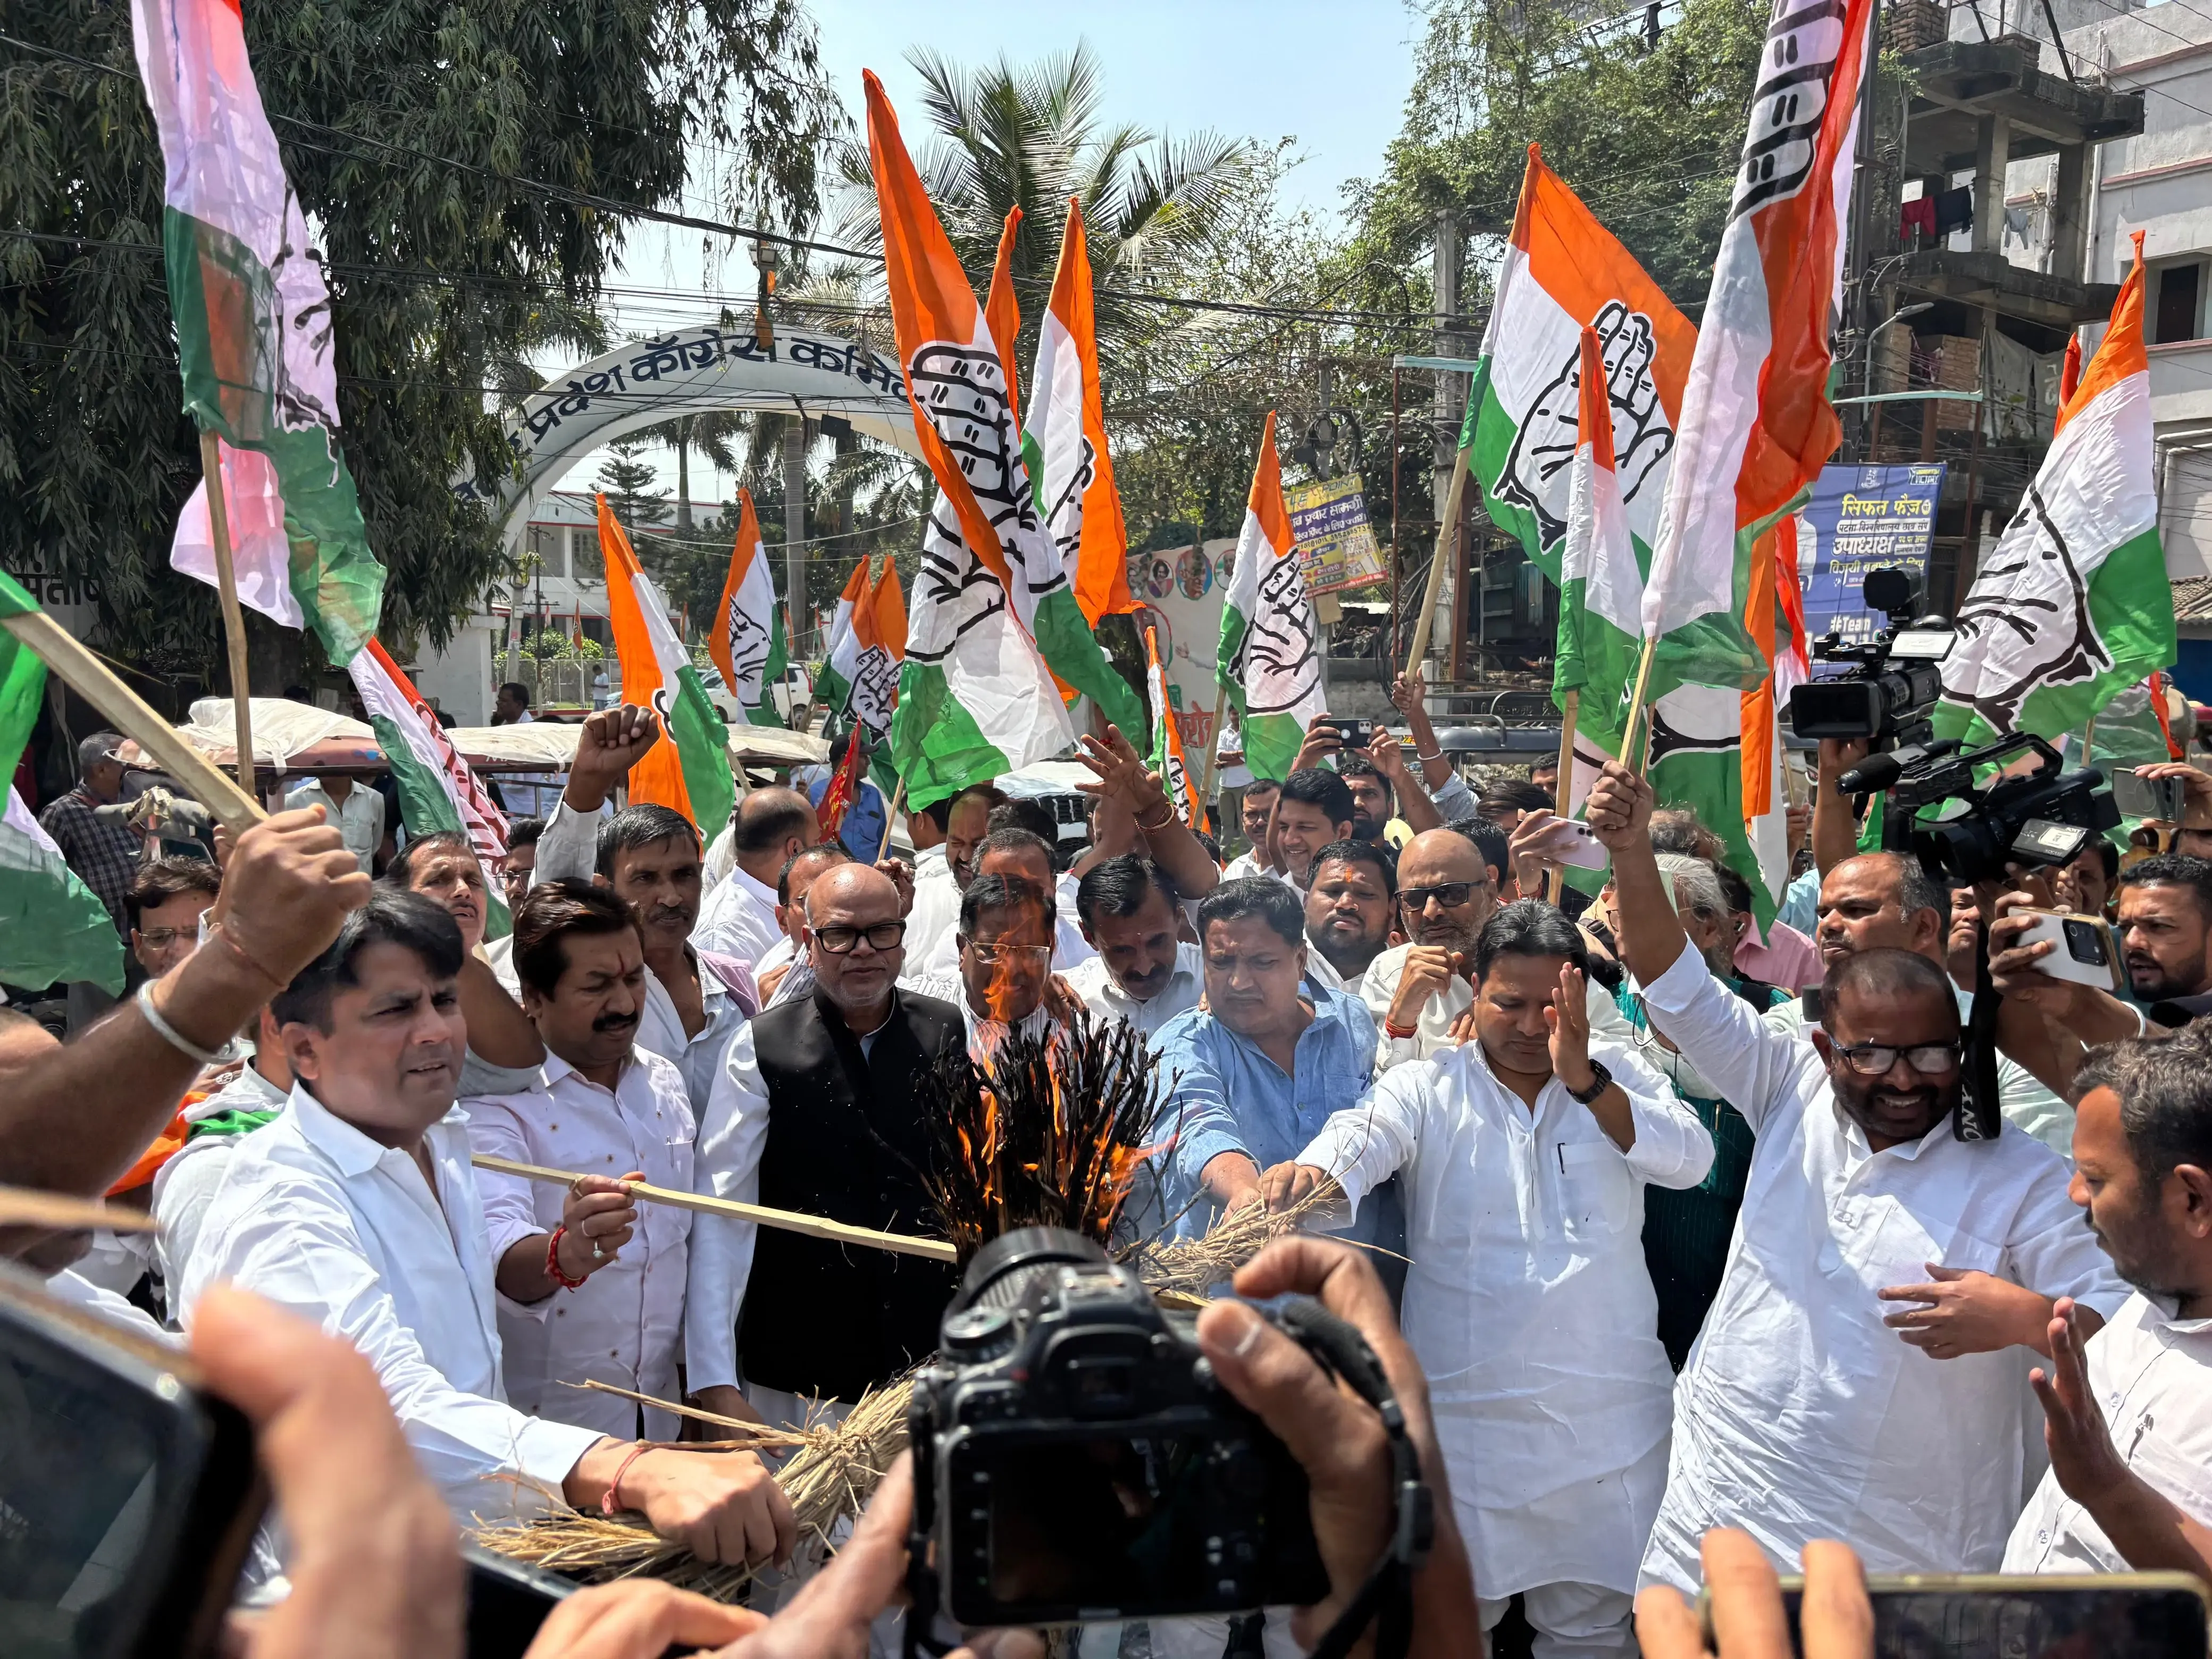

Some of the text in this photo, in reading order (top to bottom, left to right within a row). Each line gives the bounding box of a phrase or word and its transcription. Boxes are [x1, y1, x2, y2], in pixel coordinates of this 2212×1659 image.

[1841, 493, 1889, 516] सिफत
[1832, 535, 1895, 555] उपाध्यक्ष
[1830, 616, 1872, 633] #Team
[1962, 1084, 1983, 1141] ONY
